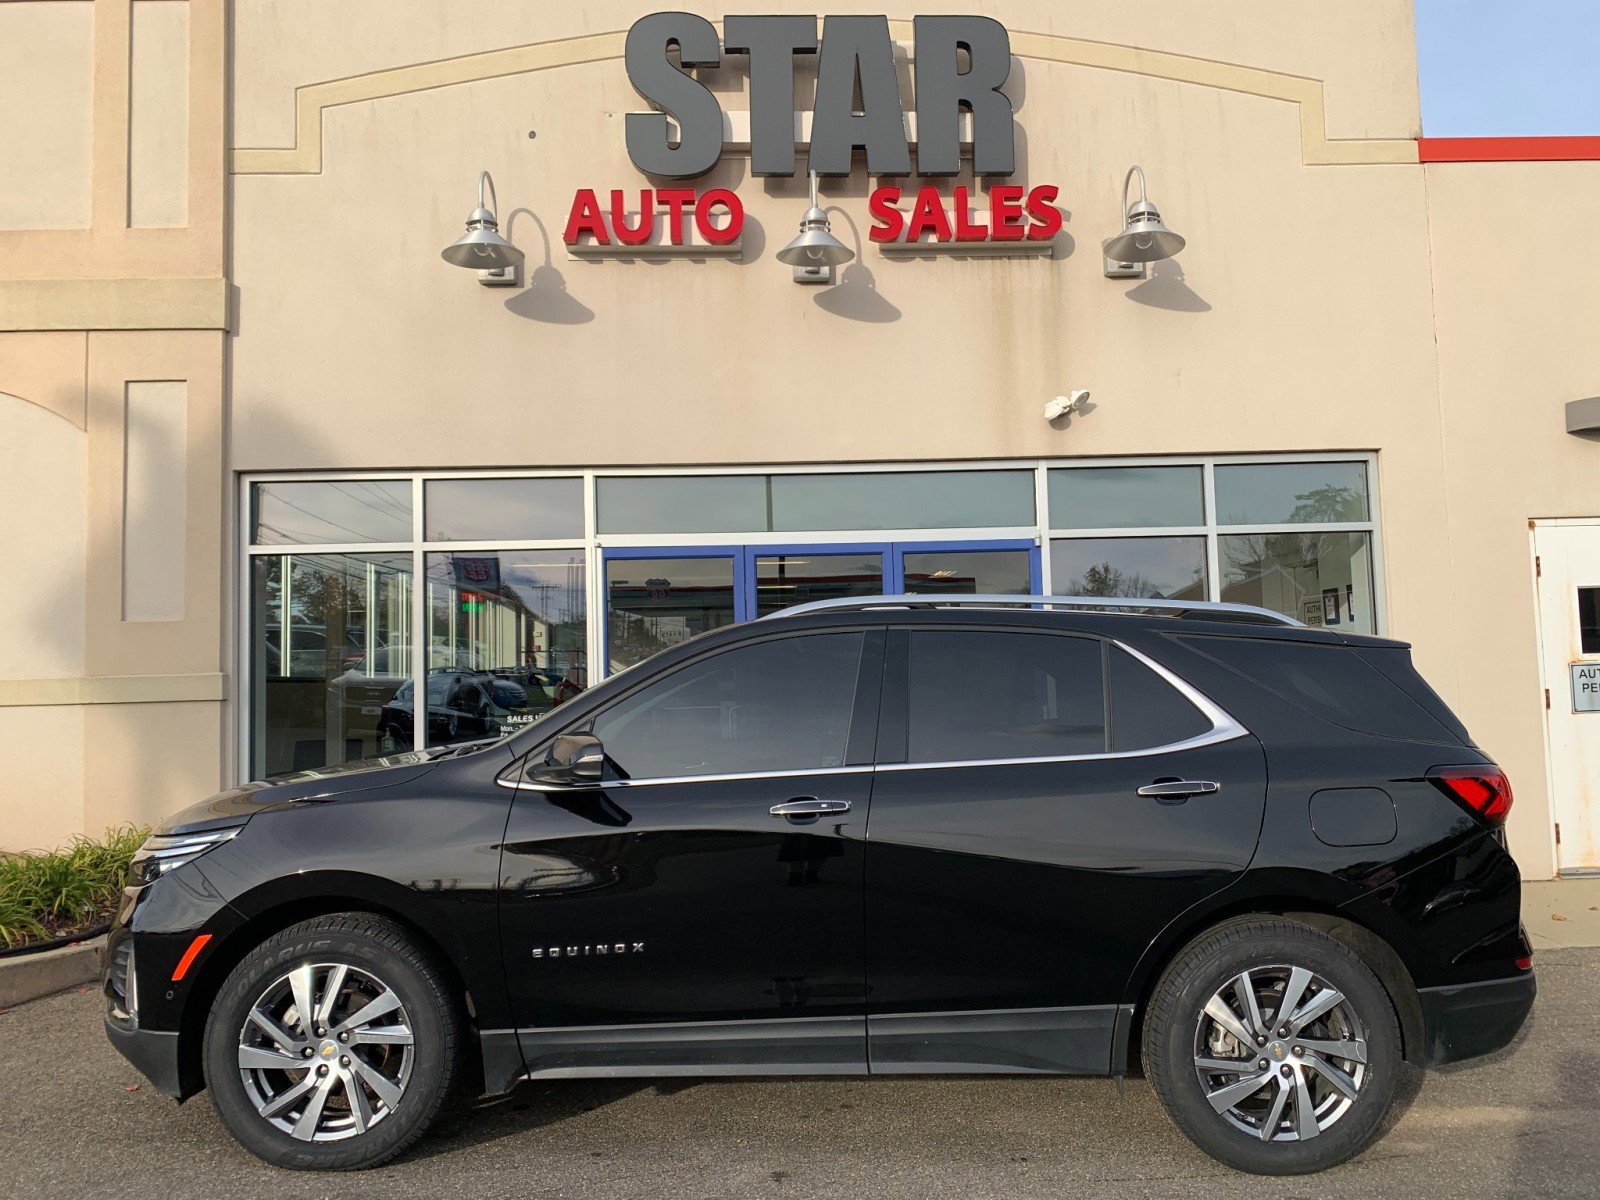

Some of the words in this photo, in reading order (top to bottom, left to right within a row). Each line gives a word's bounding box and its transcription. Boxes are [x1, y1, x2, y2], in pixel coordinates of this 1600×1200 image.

[625, 12, 1015, 179] STAR
[563, 188, 744, 246] AUTO
[868, 185, 1063, 243] SALES
[1582, 683, 1600, 693] PE
[507, 715, 534, 723] SALES
[532, 942, 644, 958] EQUINOX
